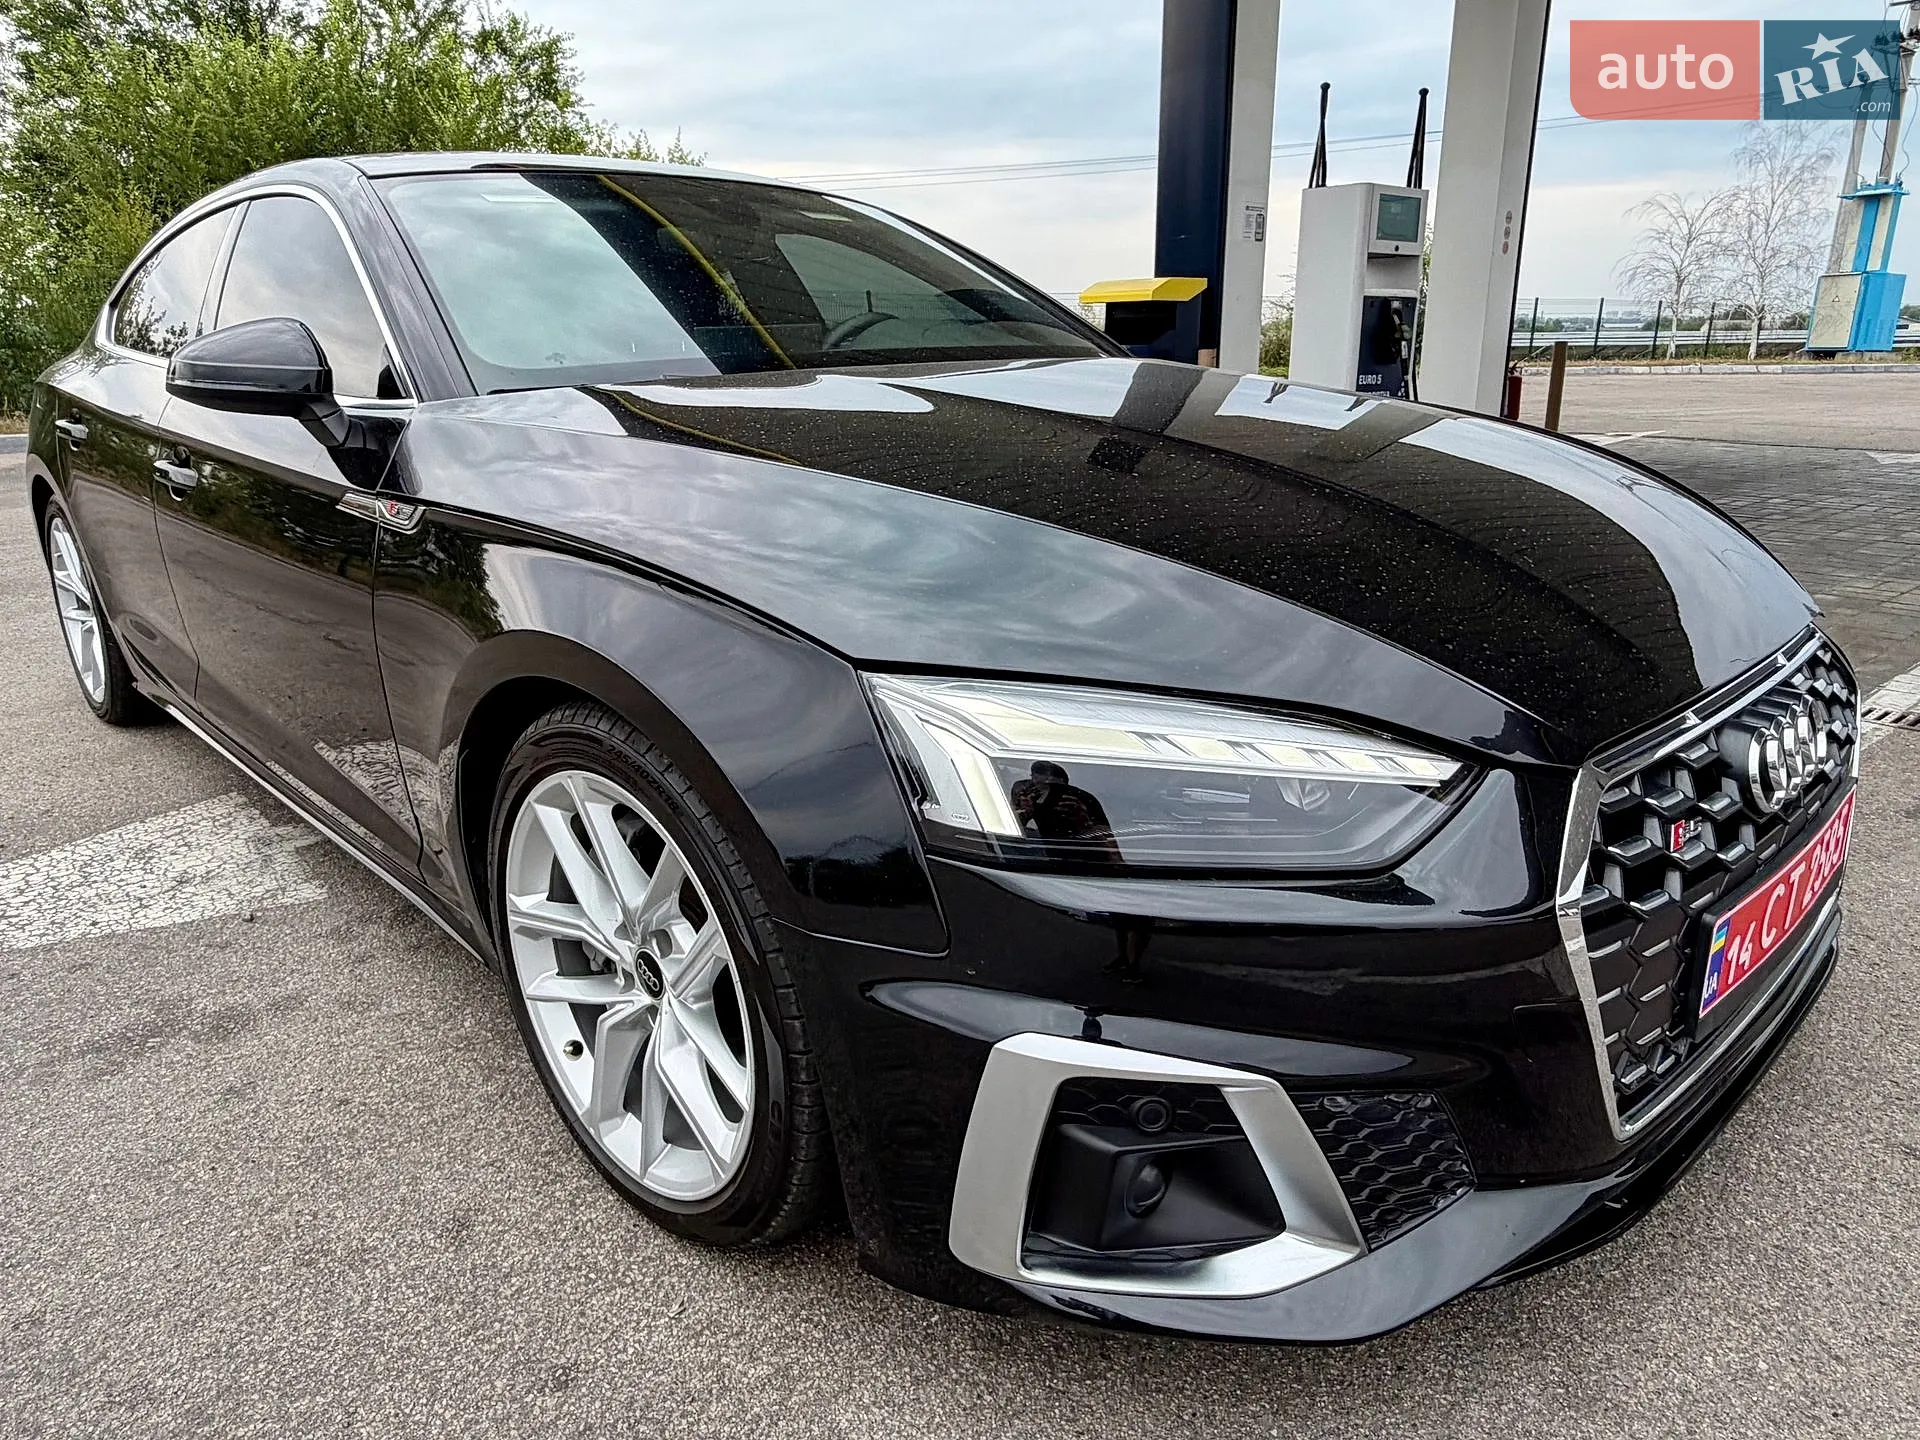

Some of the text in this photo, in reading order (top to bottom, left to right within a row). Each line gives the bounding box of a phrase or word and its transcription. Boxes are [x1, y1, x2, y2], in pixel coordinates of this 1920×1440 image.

[1358, 374, 1382, 385] EURO 5
[1727, 920, 1756, 985] 14
[1761, 861, 1806, 950] CT
[1703, 976, 1718, 999] UA
